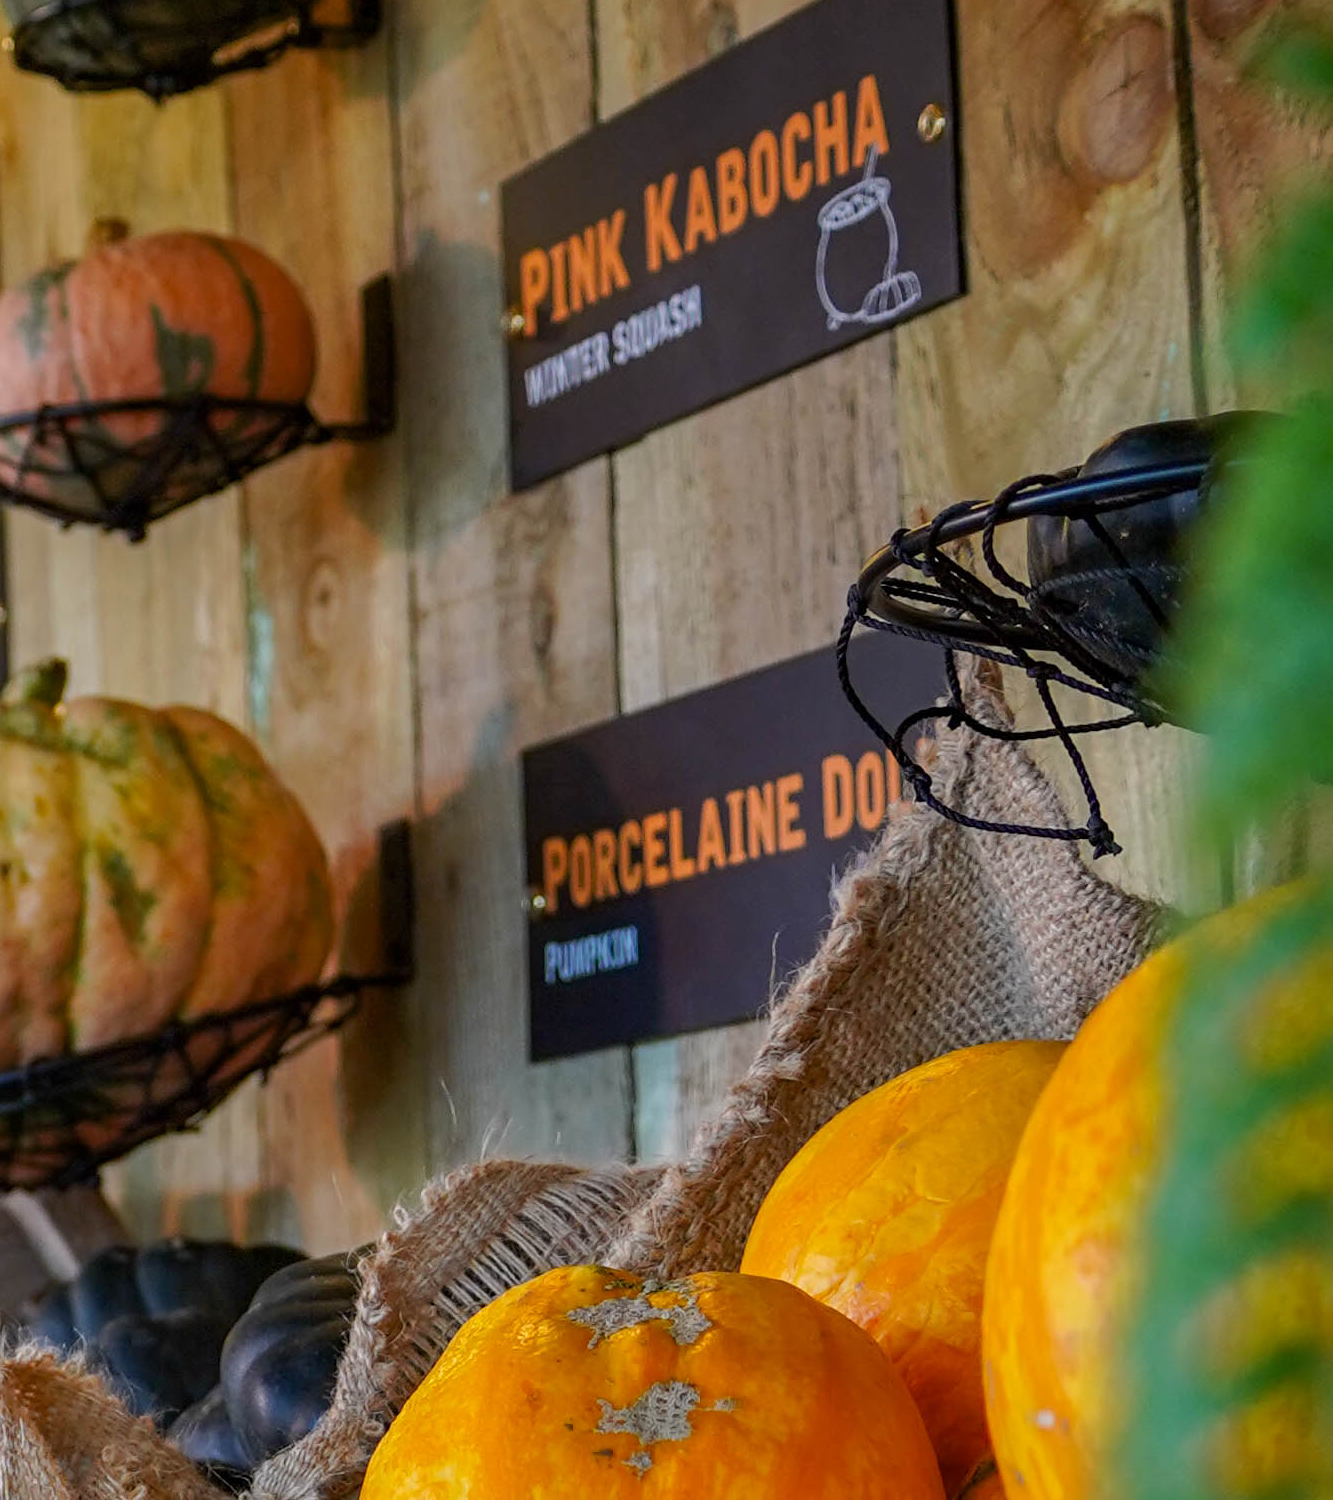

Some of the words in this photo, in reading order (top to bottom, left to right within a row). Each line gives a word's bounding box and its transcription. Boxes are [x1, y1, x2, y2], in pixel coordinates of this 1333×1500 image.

[520, 209, 630, 336] PINK
[644, 74, 889, 273] KABOCHA
[524, 331, 610, 407] WINTER
[612, 284, 702, 365] SQUASH
[543, 772, 807, 914] PORCELAINE
[545, 925, 638, 984] PUMPKIN
